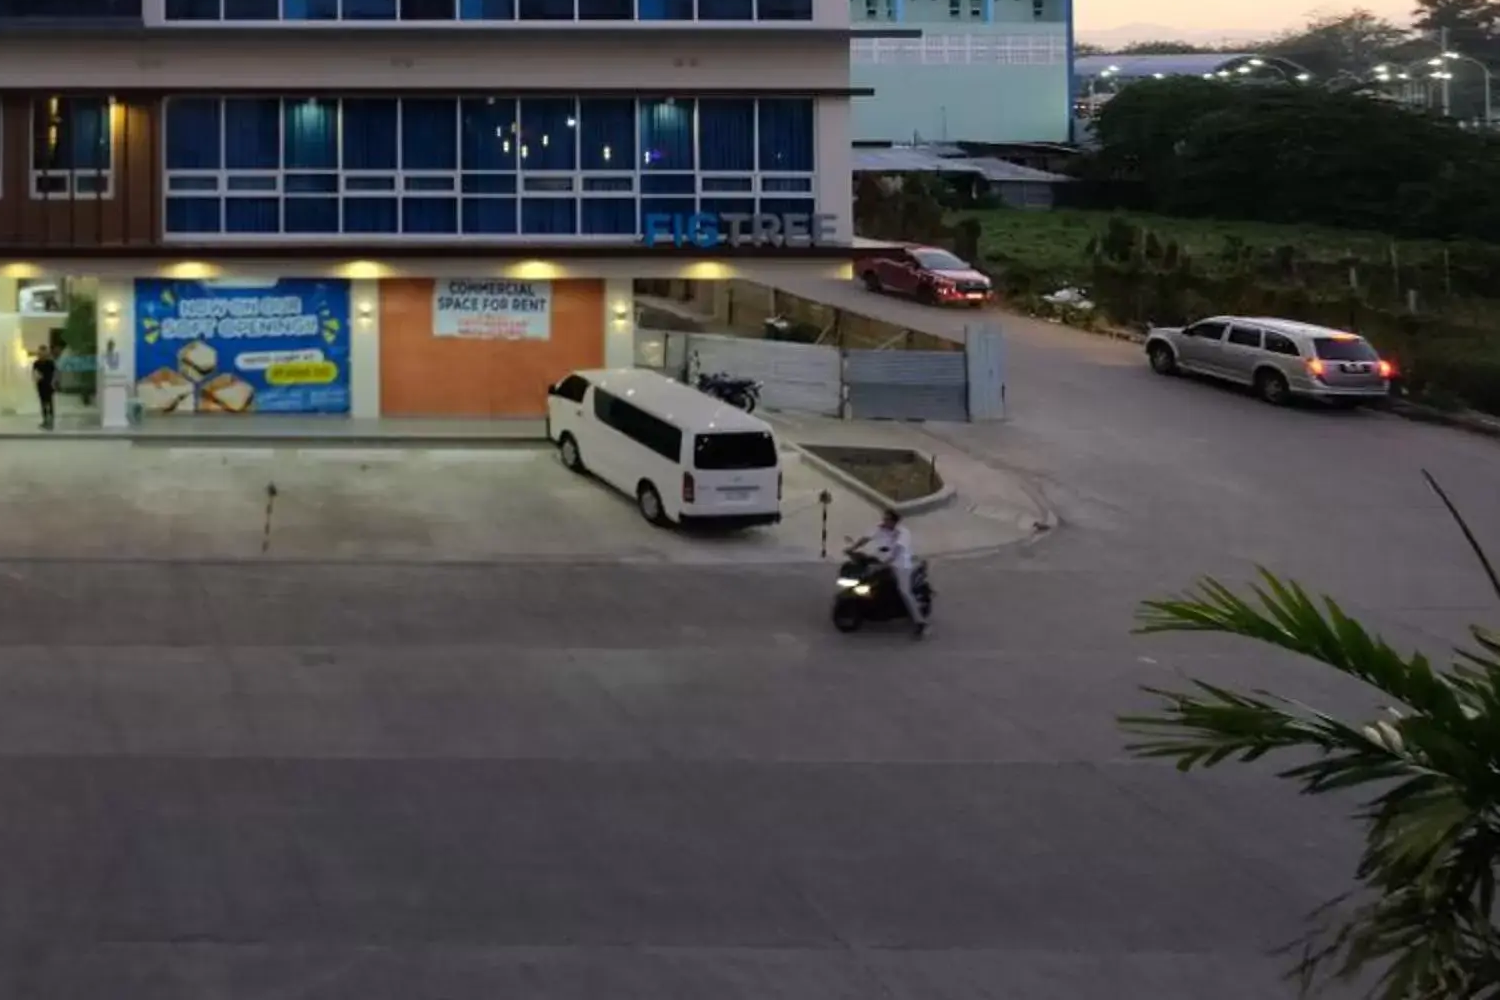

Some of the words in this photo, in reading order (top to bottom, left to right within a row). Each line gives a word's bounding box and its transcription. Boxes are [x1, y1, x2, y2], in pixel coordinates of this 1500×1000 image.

[449, 281, 535, 297] COMMERCIAL
[438, 297, 479, 311] SPACE
[482, 298, 508, 311] FOR
[512, 298, 547, 312] RENT
